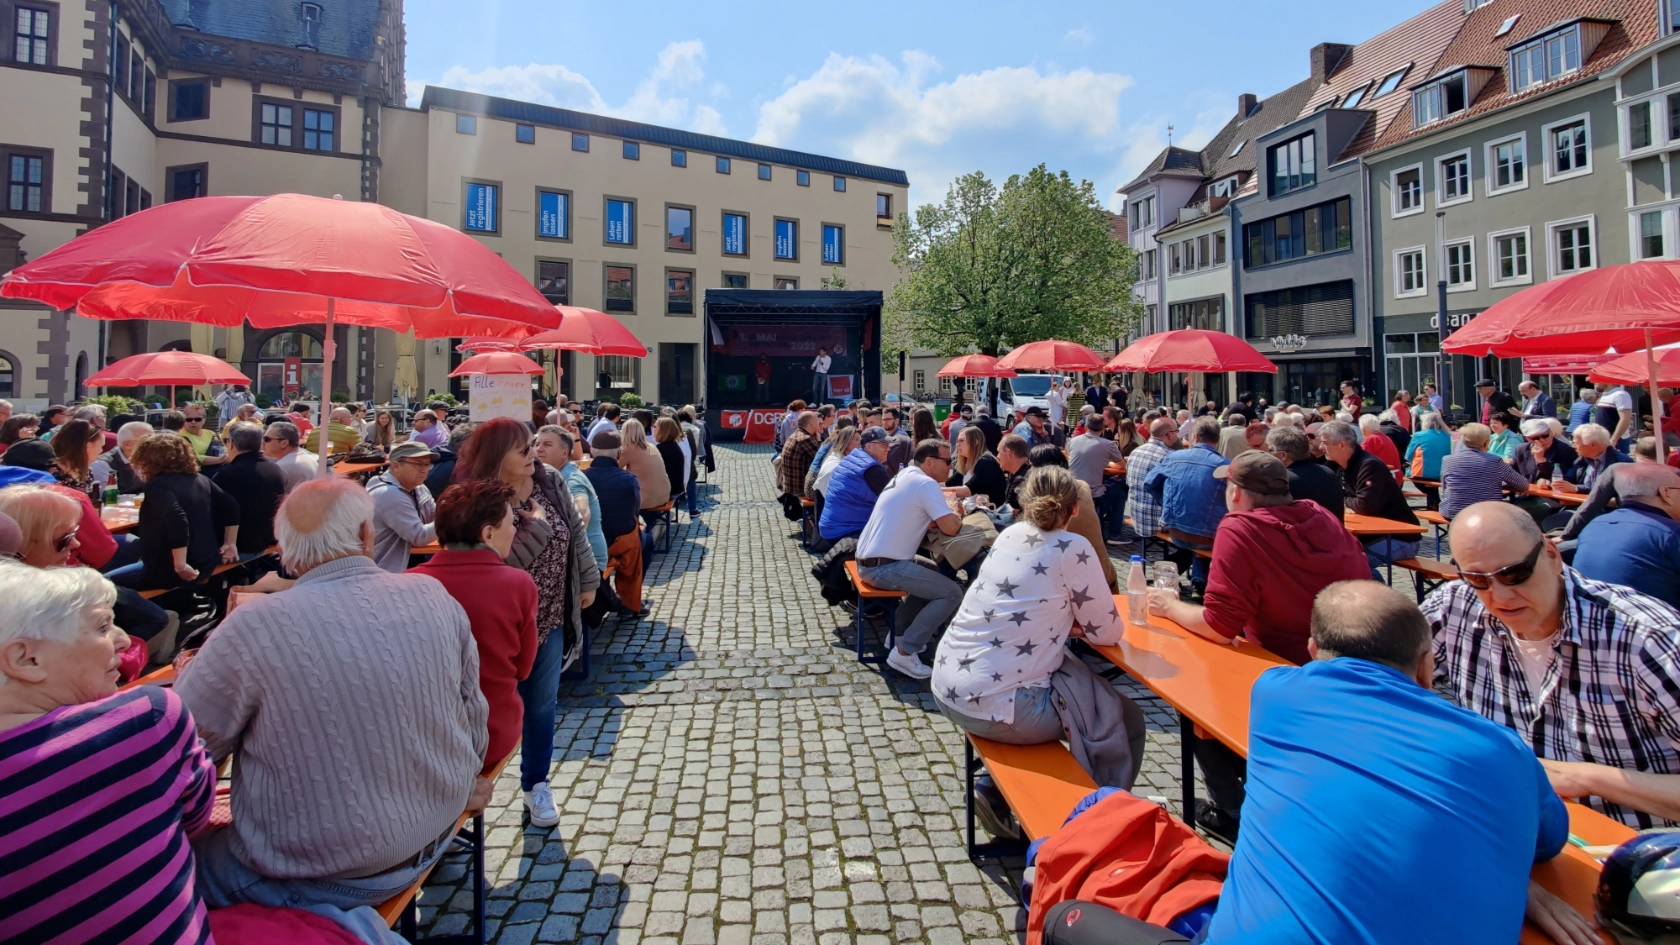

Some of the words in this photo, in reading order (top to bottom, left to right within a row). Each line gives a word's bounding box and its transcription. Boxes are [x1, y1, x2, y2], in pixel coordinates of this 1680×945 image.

[477, 187, 485, 228] registrieren
[1430, 313, 1470, 328] dan
[756, 333, 777, 341] MAI
[791, 341, 816, 350] 2022
[475, 375, 495, 388] Alle
